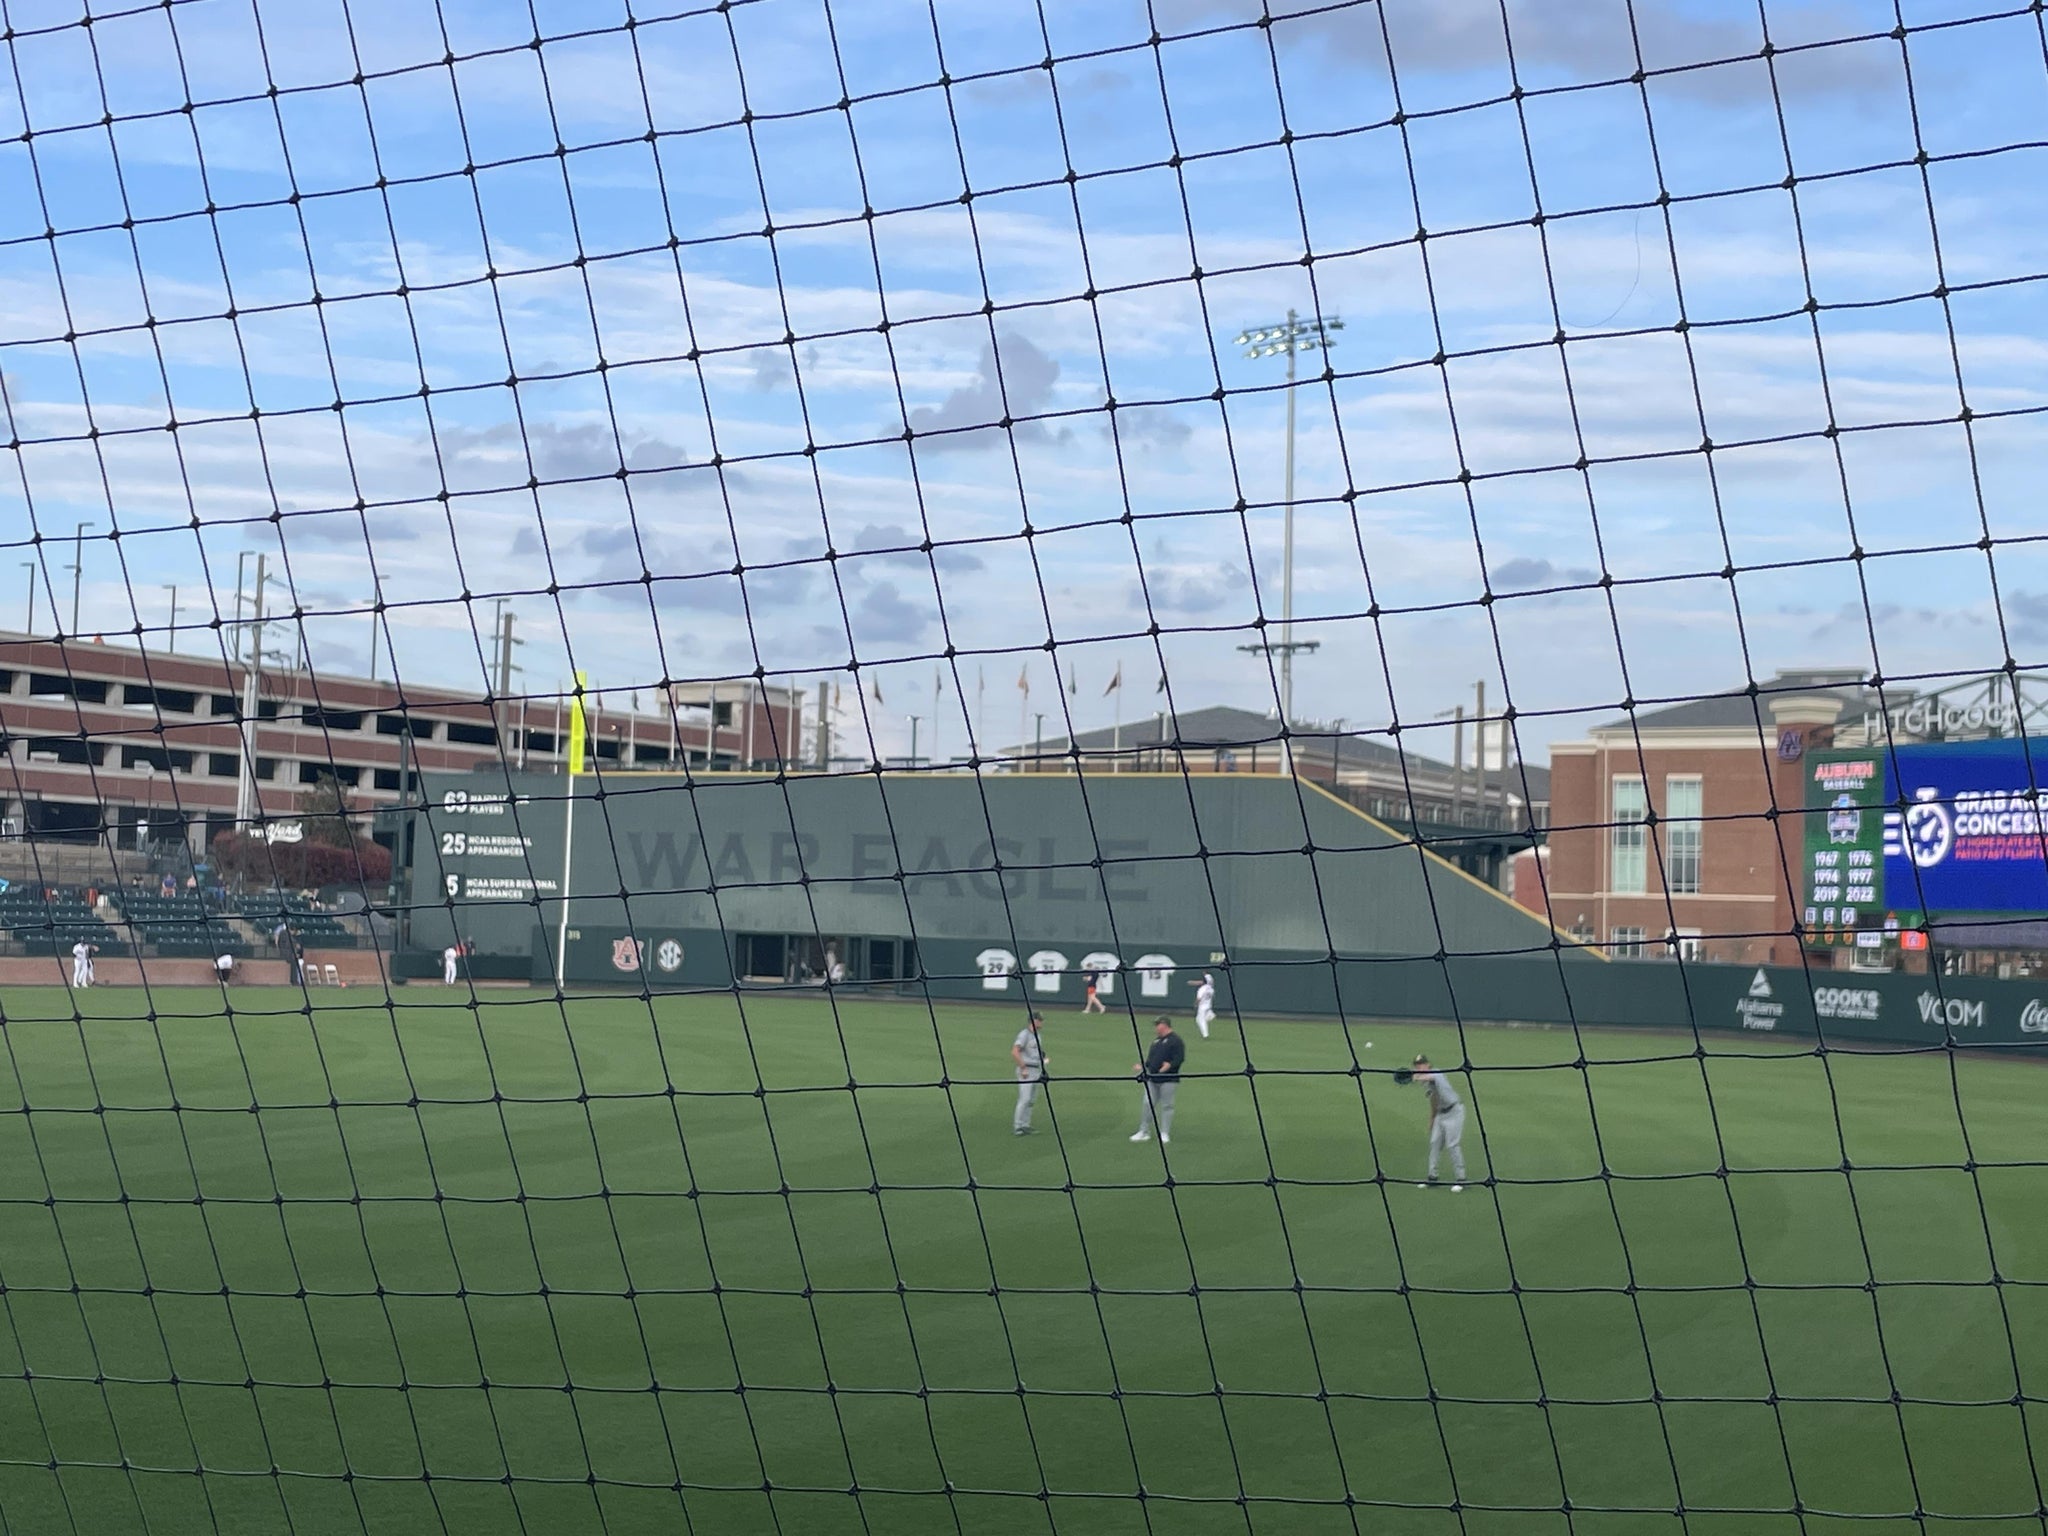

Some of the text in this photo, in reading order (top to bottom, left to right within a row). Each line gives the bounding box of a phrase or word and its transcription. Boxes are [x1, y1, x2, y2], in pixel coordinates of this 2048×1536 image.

[1814, 761, 1874, 780] AUBURN
[1823, 779, 1864, 791] BASEBALL
[444, 790, 467, 813] 63
[1954, 789, 2006, 813] GRAB
[441, 832, 466, 855] 25
[627, 831, 1150, 902] WAR EAGLE
[1815, 851, 1873, 866] 1967 1976
[1814, 868, 1874, 884] 1994 1997
[1813, 886, 1875, 902] 2019 2022
[988, 961, 1004, 973] 29
[1814, 987, 1880, 1008] COOK'S
[1736, 998, 1783, 1016] Alabama
[1743, 1015, 1776, 1030] Power
